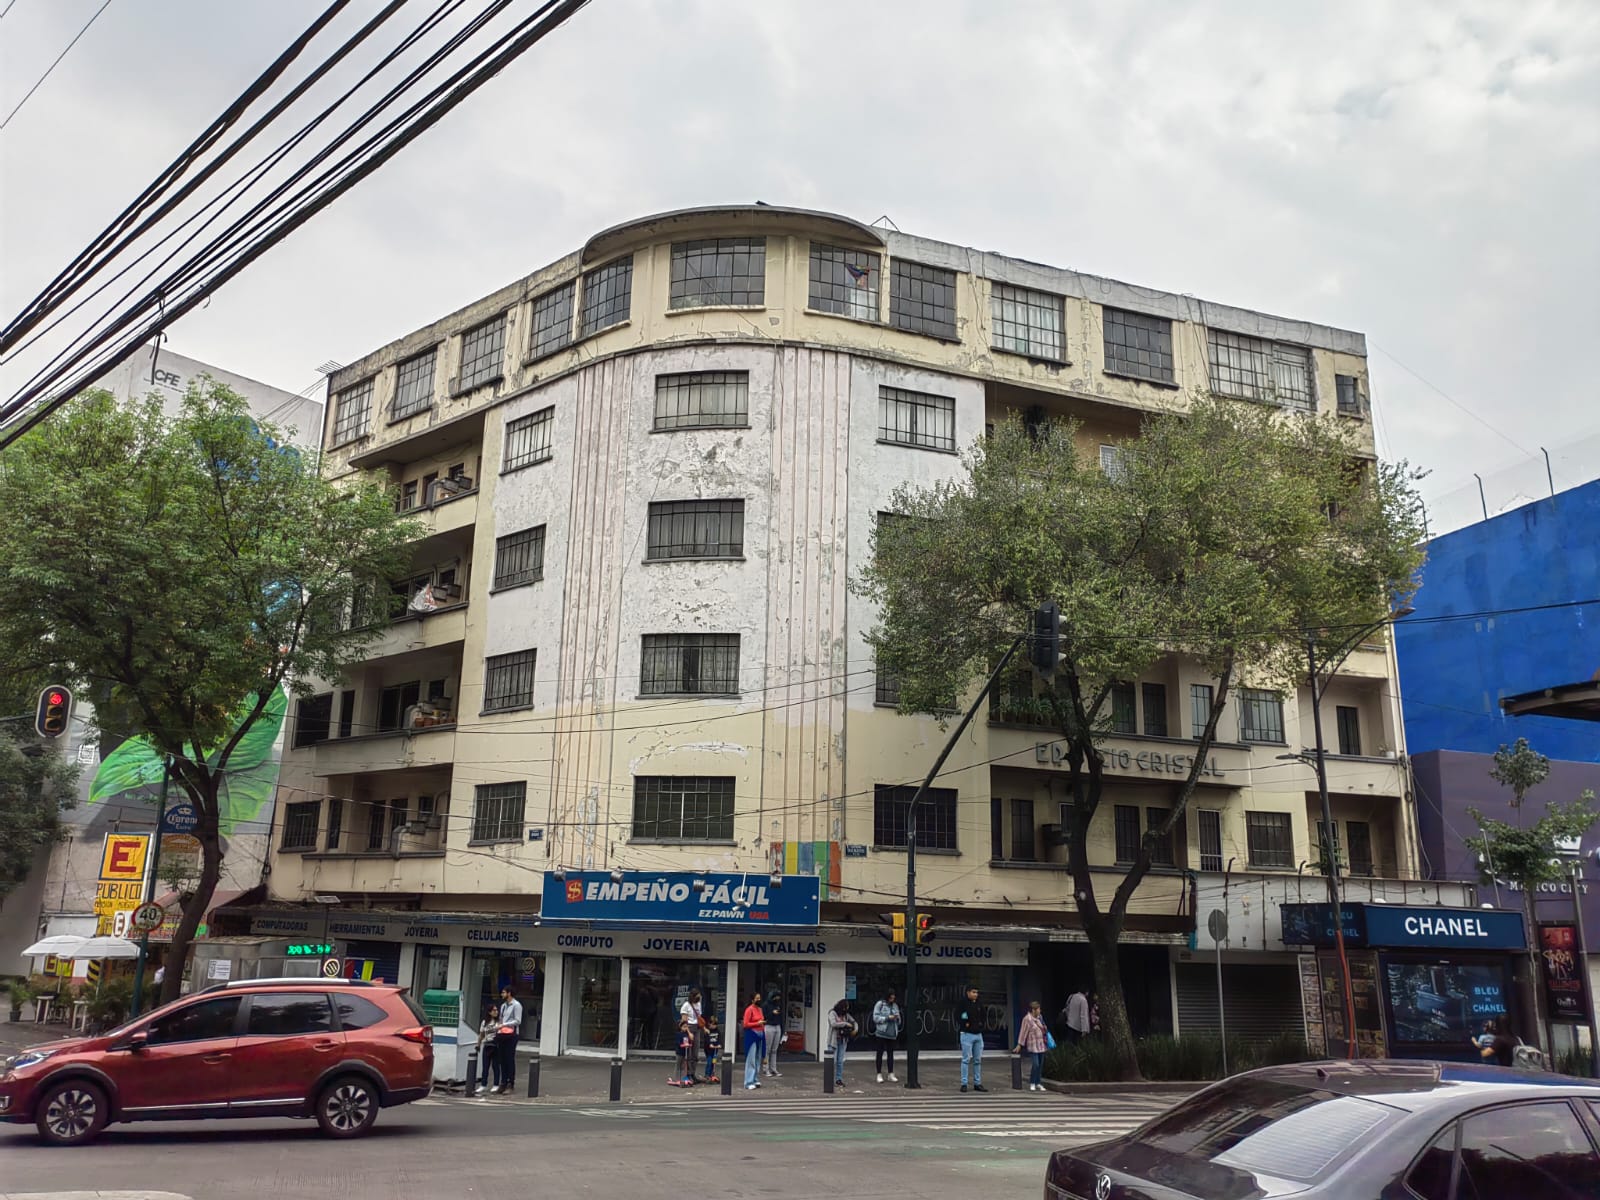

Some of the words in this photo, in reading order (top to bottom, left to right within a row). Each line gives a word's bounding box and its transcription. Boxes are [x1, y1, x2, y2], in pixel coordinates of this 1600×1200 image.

[154, 369, 181, 386] CFE
[1036, 742, 1130, 769] EDCIO
[109, 841, 142, 873] E
[585, 878, 690, 903] EMPEÑO
[699, 879, 770, 906] FÁCIL
[1510, 881, 1557, 893] MCO
[1561, 883, 1588, 894] CIY
[140, 908, 158, 921] 40
[256, 919, 309, 932] COMPUTADORAS
[329, 922, 386, 936] HERRAMIENTAS
[404, 926, 439, 939] JOYERIA
[1404, 915, 1489, 938] CHANEL
[467, 929, 520, 943] CELULARES
[556, 934, 614, 949] COMPUTO
[643, 938, 710, 952] JOYERIA
[736, 940, 826, 955] PANTALLAS
[936, 946, 993, 959] JUEGOS
[1474, 986, 1499, 996] BLEU
[1472, 1004, 1507, 1013] CHANEL
